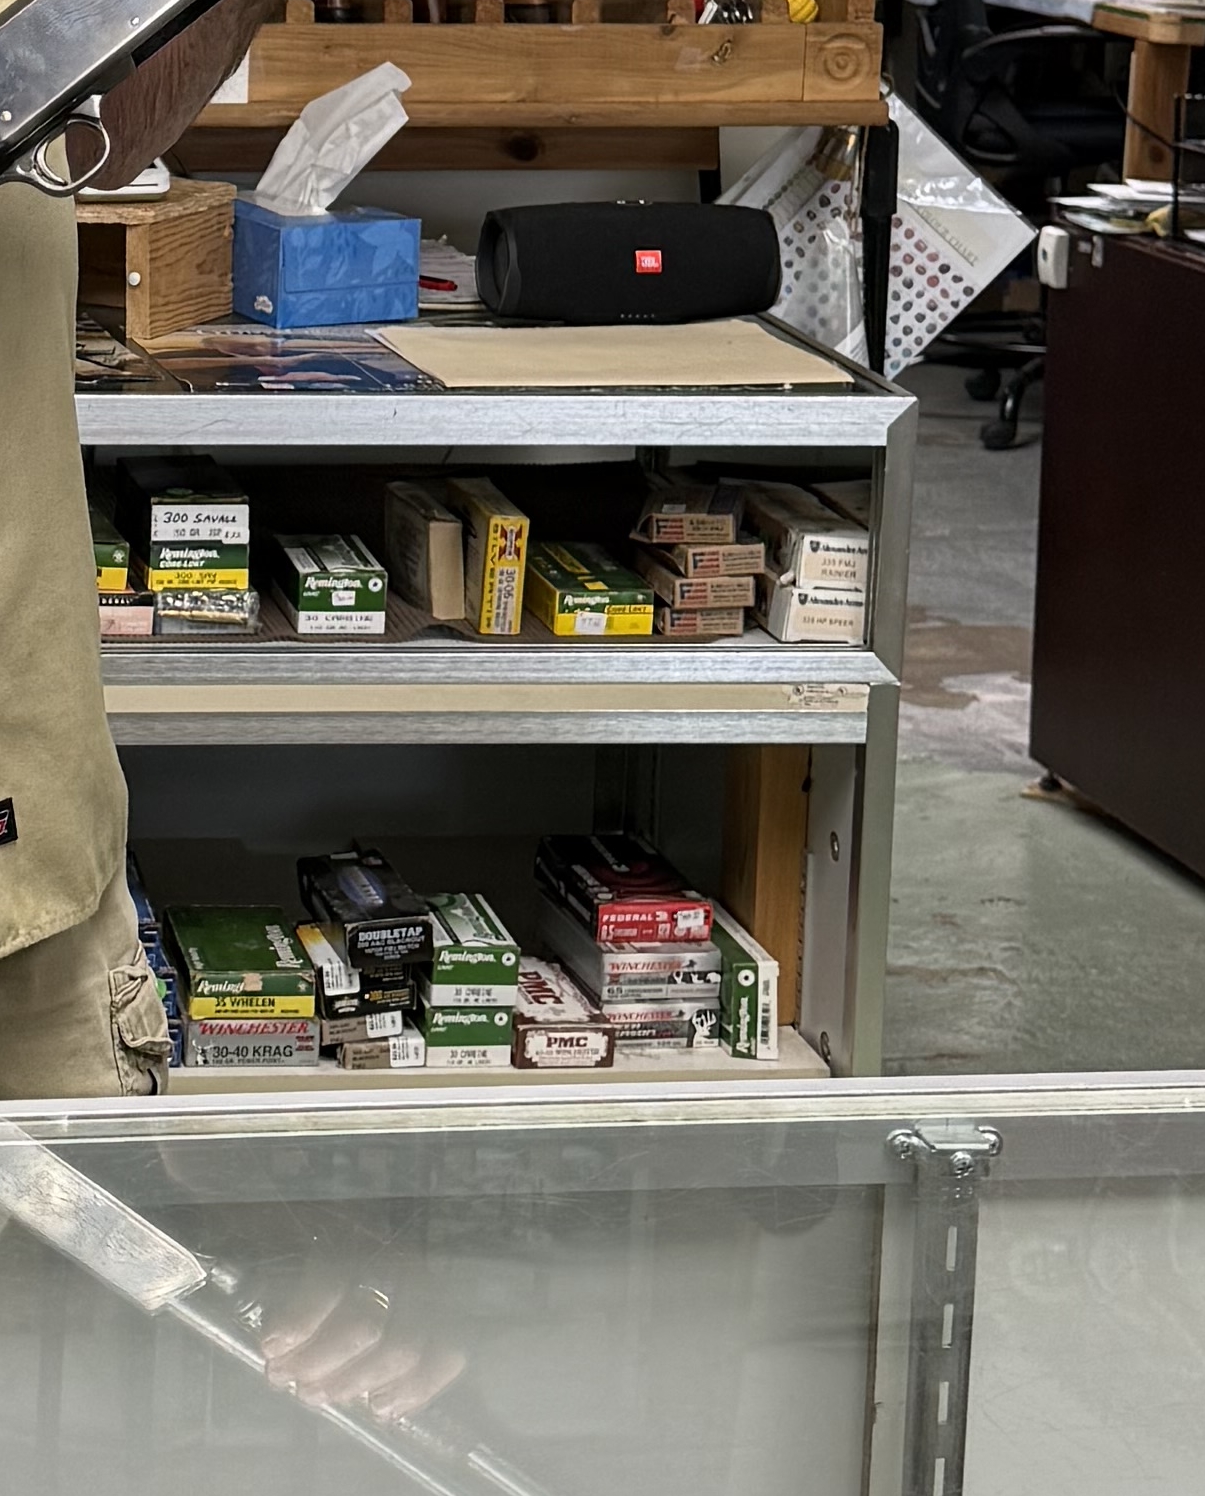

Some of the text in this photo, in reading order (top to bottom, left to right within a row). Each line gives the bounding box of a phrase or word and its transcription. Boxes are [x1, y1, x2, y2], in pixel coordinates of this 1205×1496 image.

[163, 511, 189, 524] 300
[159, 547, 220, 561] Remington
[175, 571, 193, 579] 300
[305, 576, 364, 591] Remington
[602, 914, 653, 923] FEDERAL
[358, 926, 424, 942] DOUBLETAP
[439, 950, 497, 964] Remington
[518, 971, 564, 1005] PMC
[230, 997, 276, 1007] WHELEN
[432, 1012, 489, 1025] Remington
[199, 1022, 310, 1035] WINCHESTER
[547, 1036, 589, 1048] PMC
[213, 1045, 294, 1058] 30-40 KRAG
